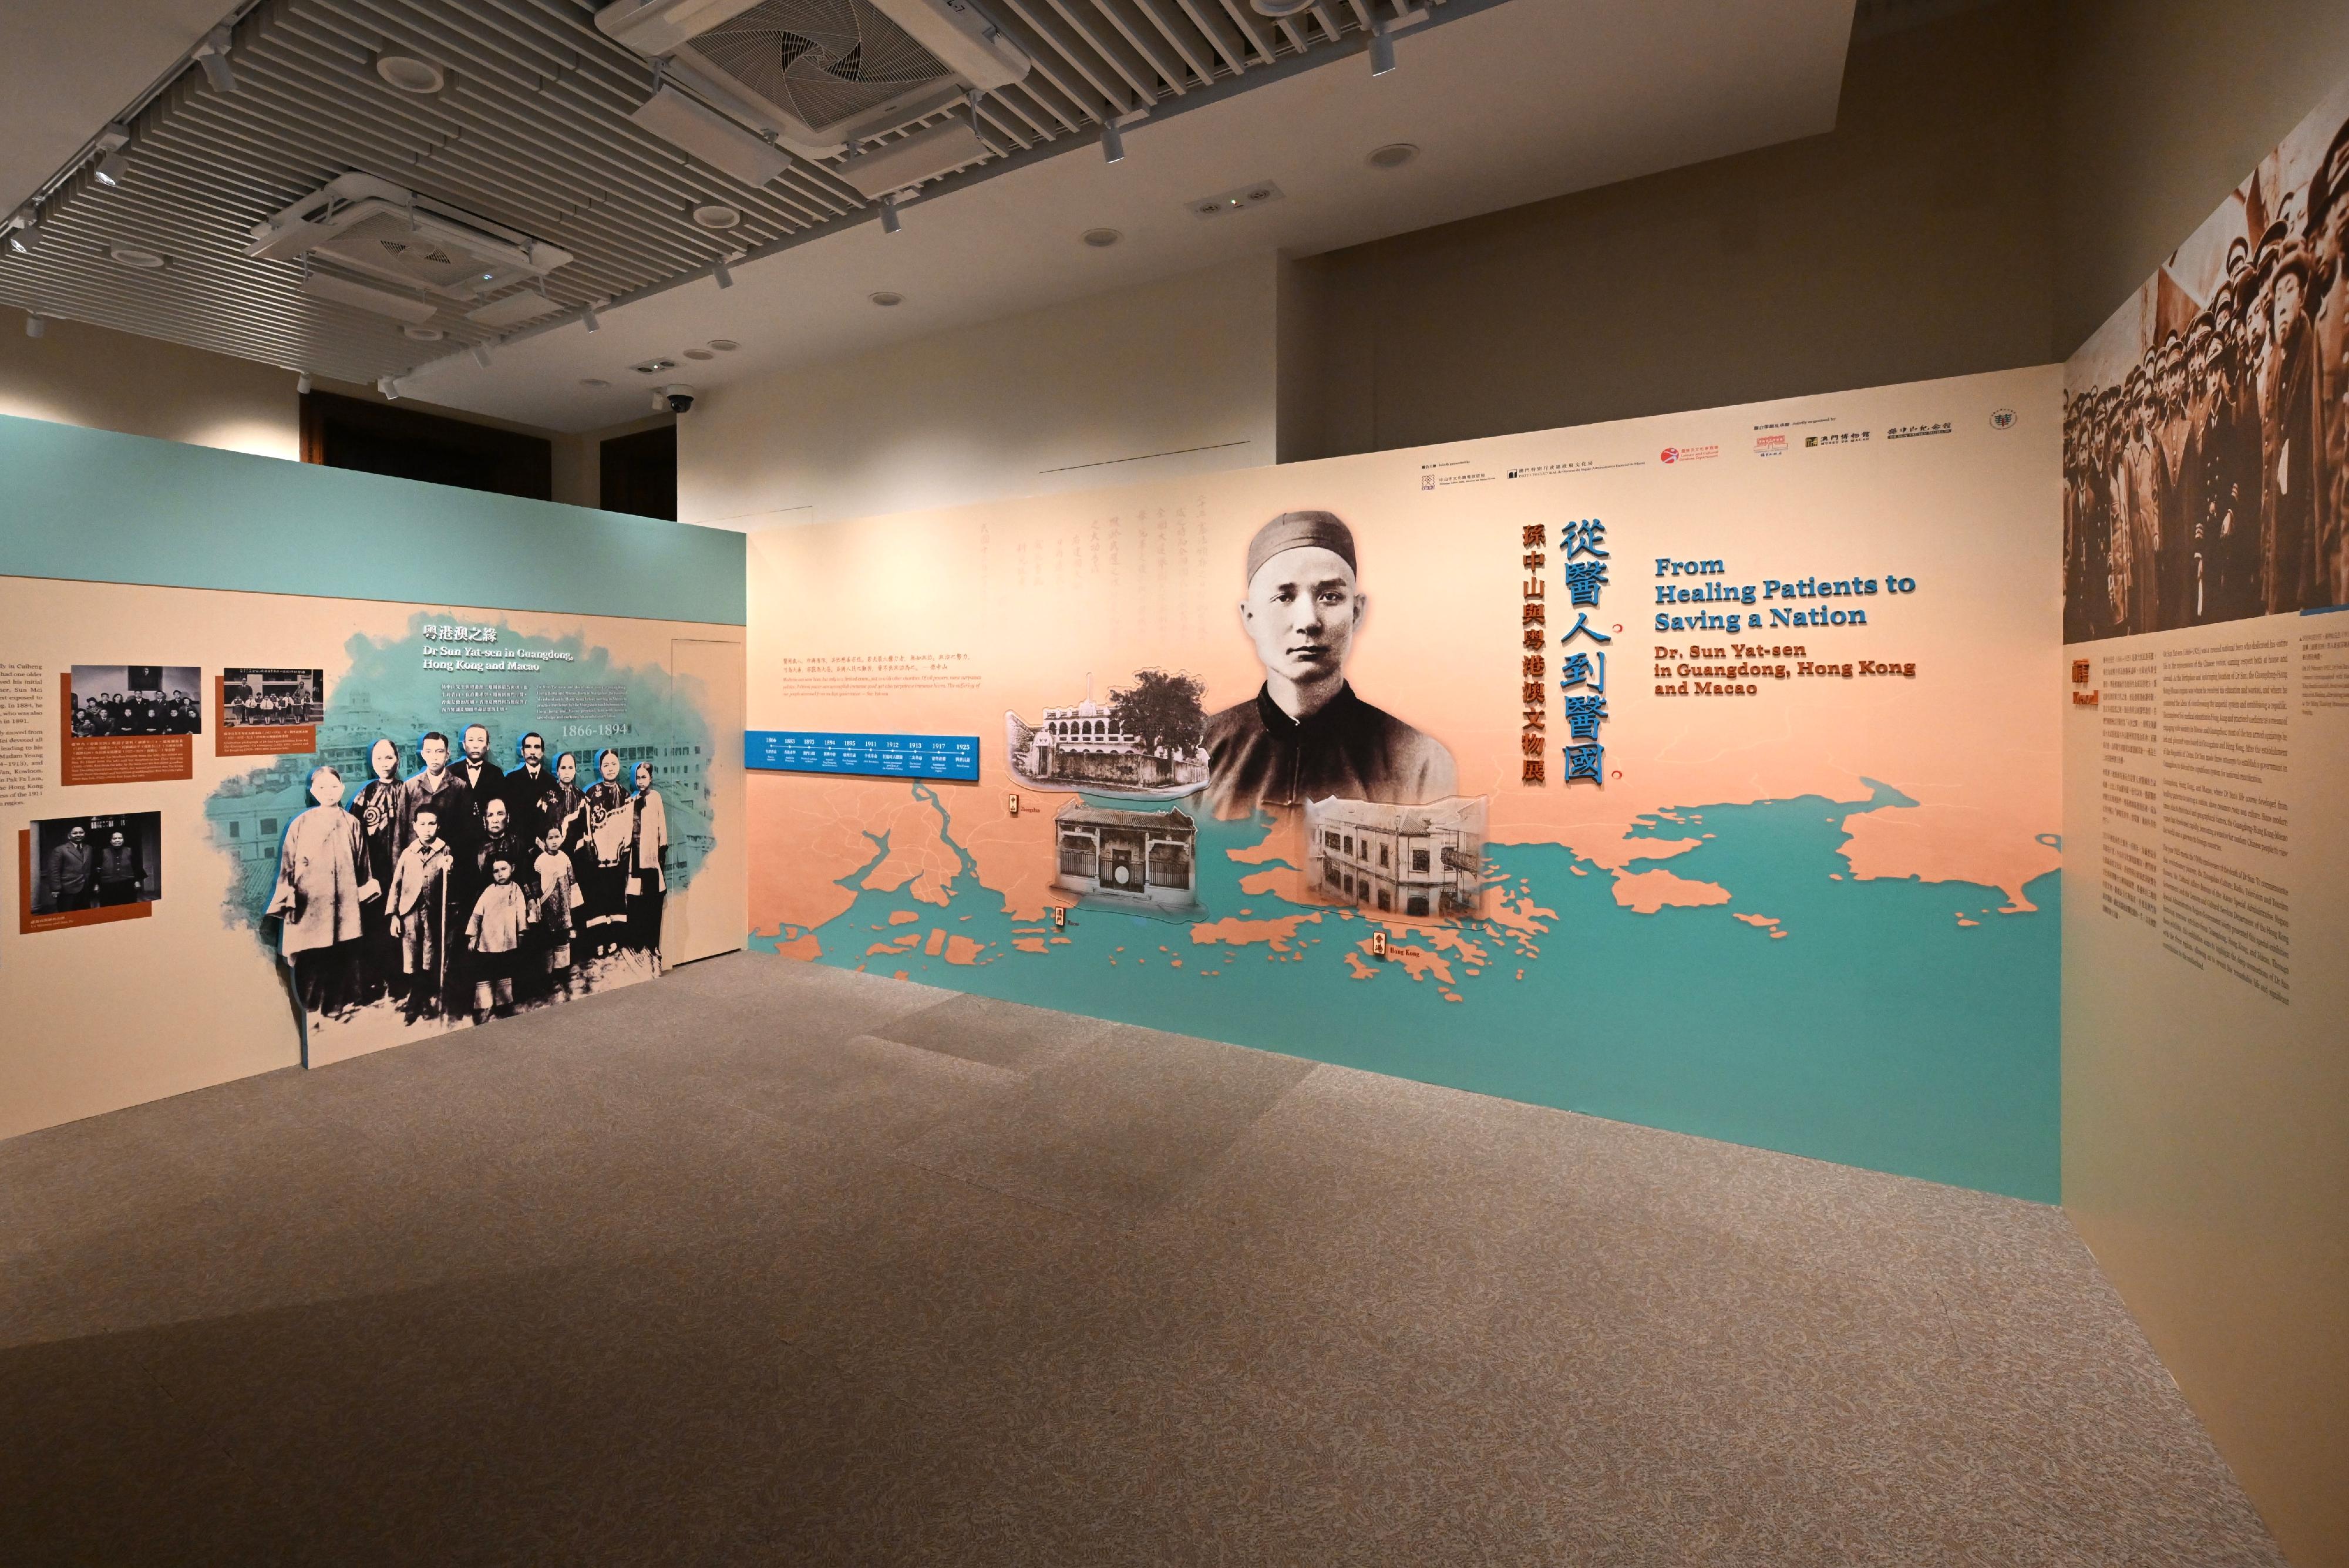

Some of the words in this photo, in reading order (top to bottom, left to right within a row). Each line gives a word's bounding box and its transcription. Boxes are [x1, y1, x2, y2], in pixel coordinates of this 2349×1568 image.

[1820, 431, 1870, 442] 澳門博物館
[1655, 558, 1725, 576] From
[1655, 581, 1756, 604] Healing
[1762, 577, 1878, 598] Patients
[1886, 575, 1916, 593] to
[1655, 610, 1741, 632] Saving
[1748, 613, 1762, 628] a
[1769, 605, 1867, 627] Nation
[423, 625, 498, 642] 粵港澳之緣
[423, 646, 438, 657] Dr
[440, 647, 462, 657] Sun
[465, 648, 503, 658] Yat-sen
[505, 648, 515, 658] in
[517, 650, 575, 662] Guangdong,
[1522, 523, 1546, 782] 孫中山與粵港澳文物展
[1560, 519, 1611, 786] 從醫人到醫國
[1654, 646, 1684, 659] Dr.
[1690, 645, 1727, 658] Sun
[1731, 644, 1806, 657] Yat-sen
[423, 660, 454, 671] Hong
[456, 660, 484, 671] Kong
[486, 661, 505, 670] and
[507, 662, 540, 671] Macao
[1654, 664, 1672, 677] in
[1677, 662, 1791, 679] Guangdong,
[1797, 661, 1853, 677] Hong
[1859, 660, 1916, 677] Kong
[1654, 681, 1689, 695] and
[1694, 681, 1758, 695] Macao
[563, 724, 628, 736] 1866-1894
[1010, 796, 1016, 810] 中山
[1375, 934, 1384, 953] 香港
[1390, 947, 1404, 956] Hong
[1405, 949, 1420, 957] Kong
